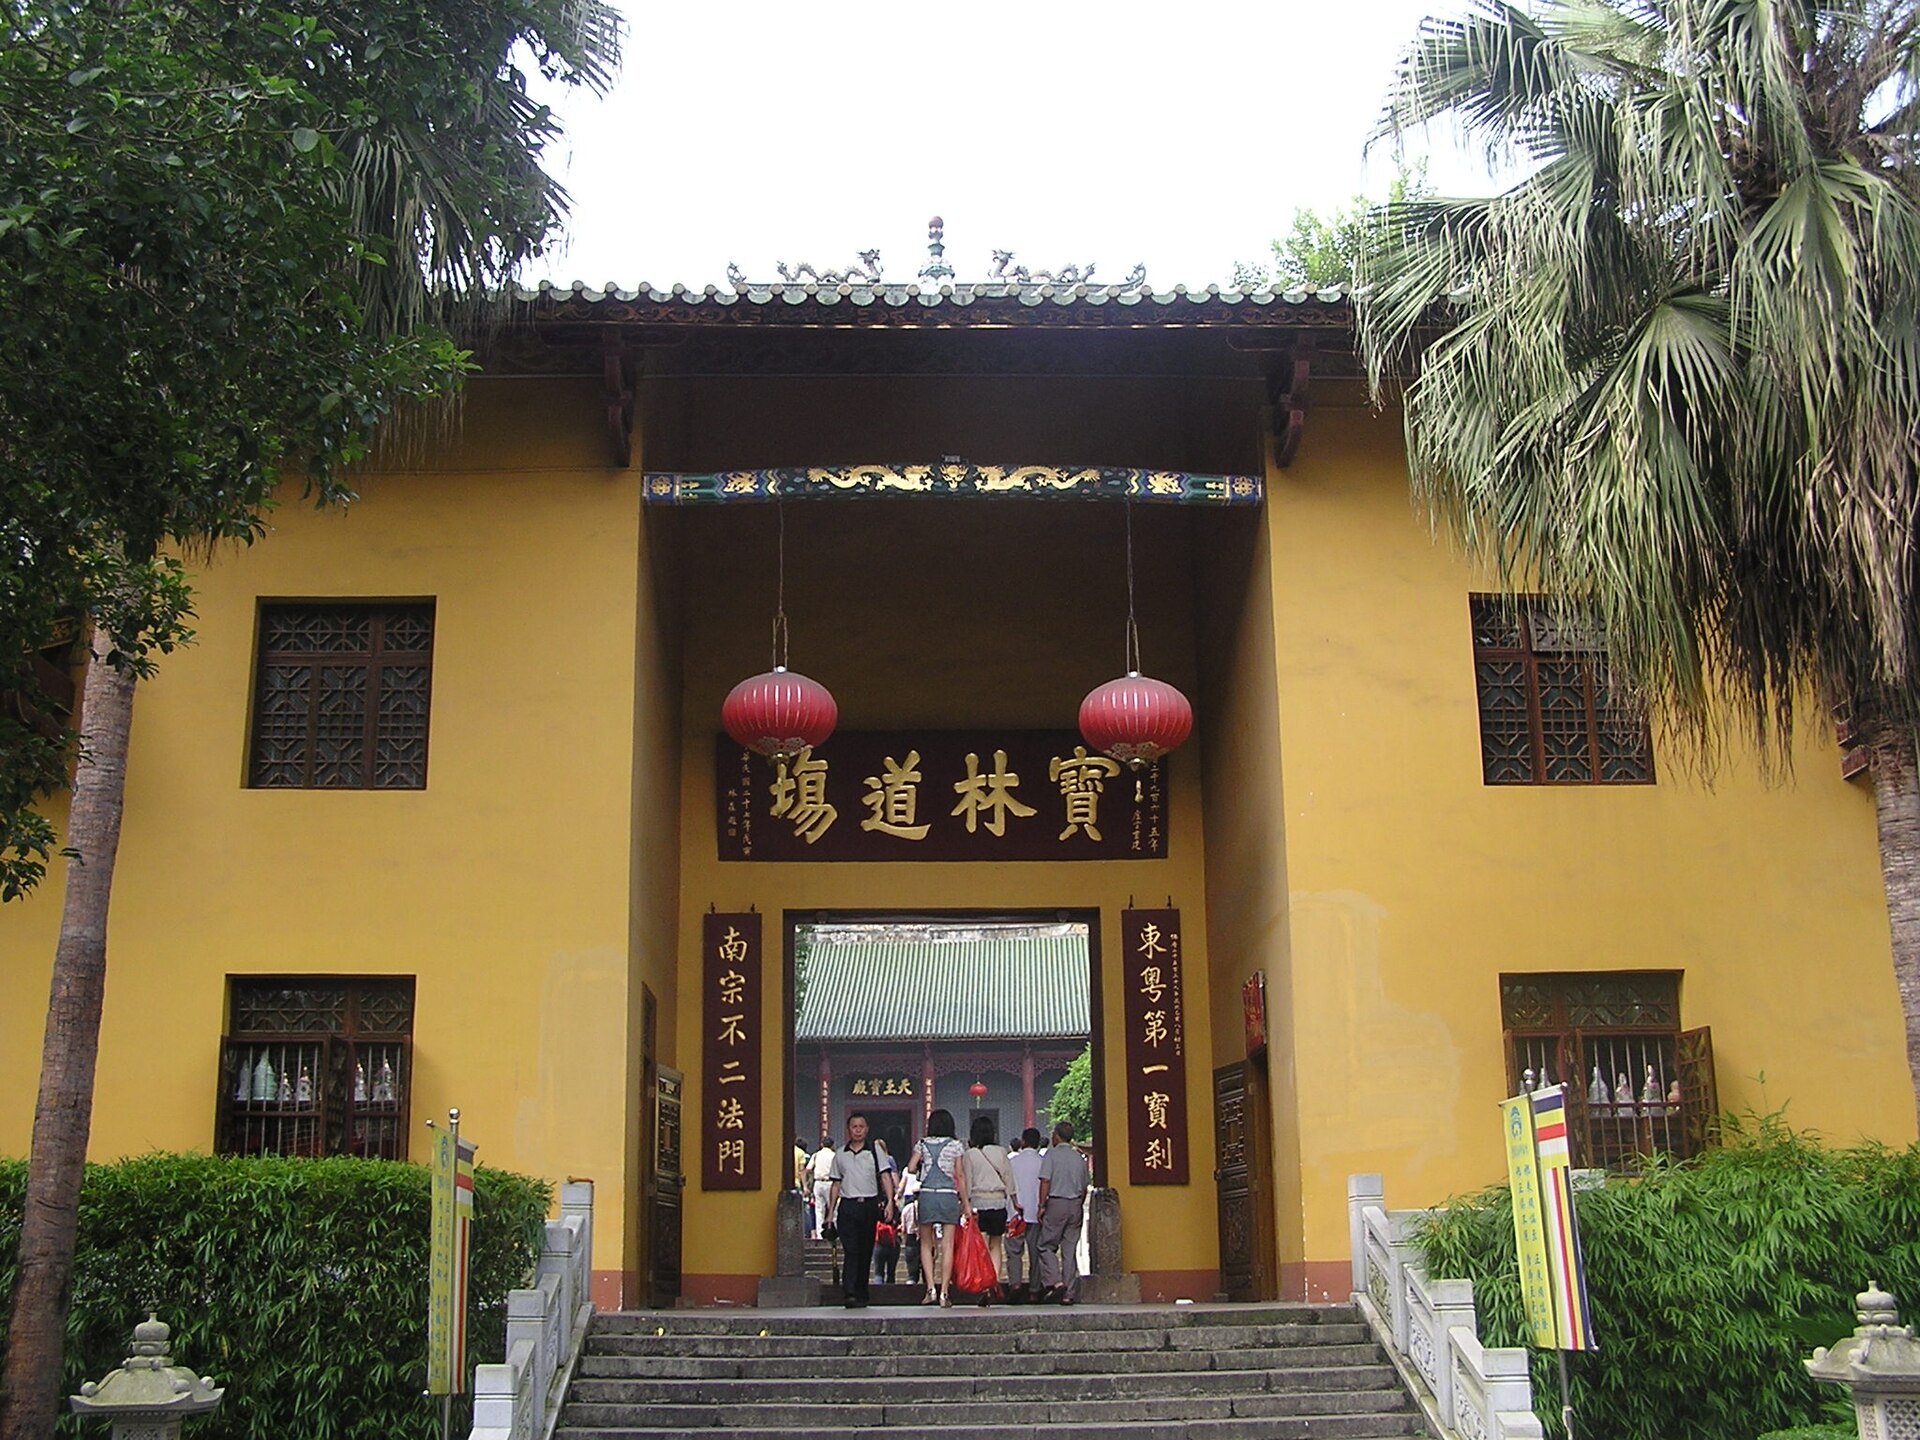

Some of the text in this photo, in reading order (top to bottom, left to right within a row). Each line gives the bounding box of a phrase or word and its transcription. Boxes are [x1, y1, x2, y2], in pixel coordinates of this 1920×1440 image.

[717, 926, 748, 1176] 南宗不二法門
